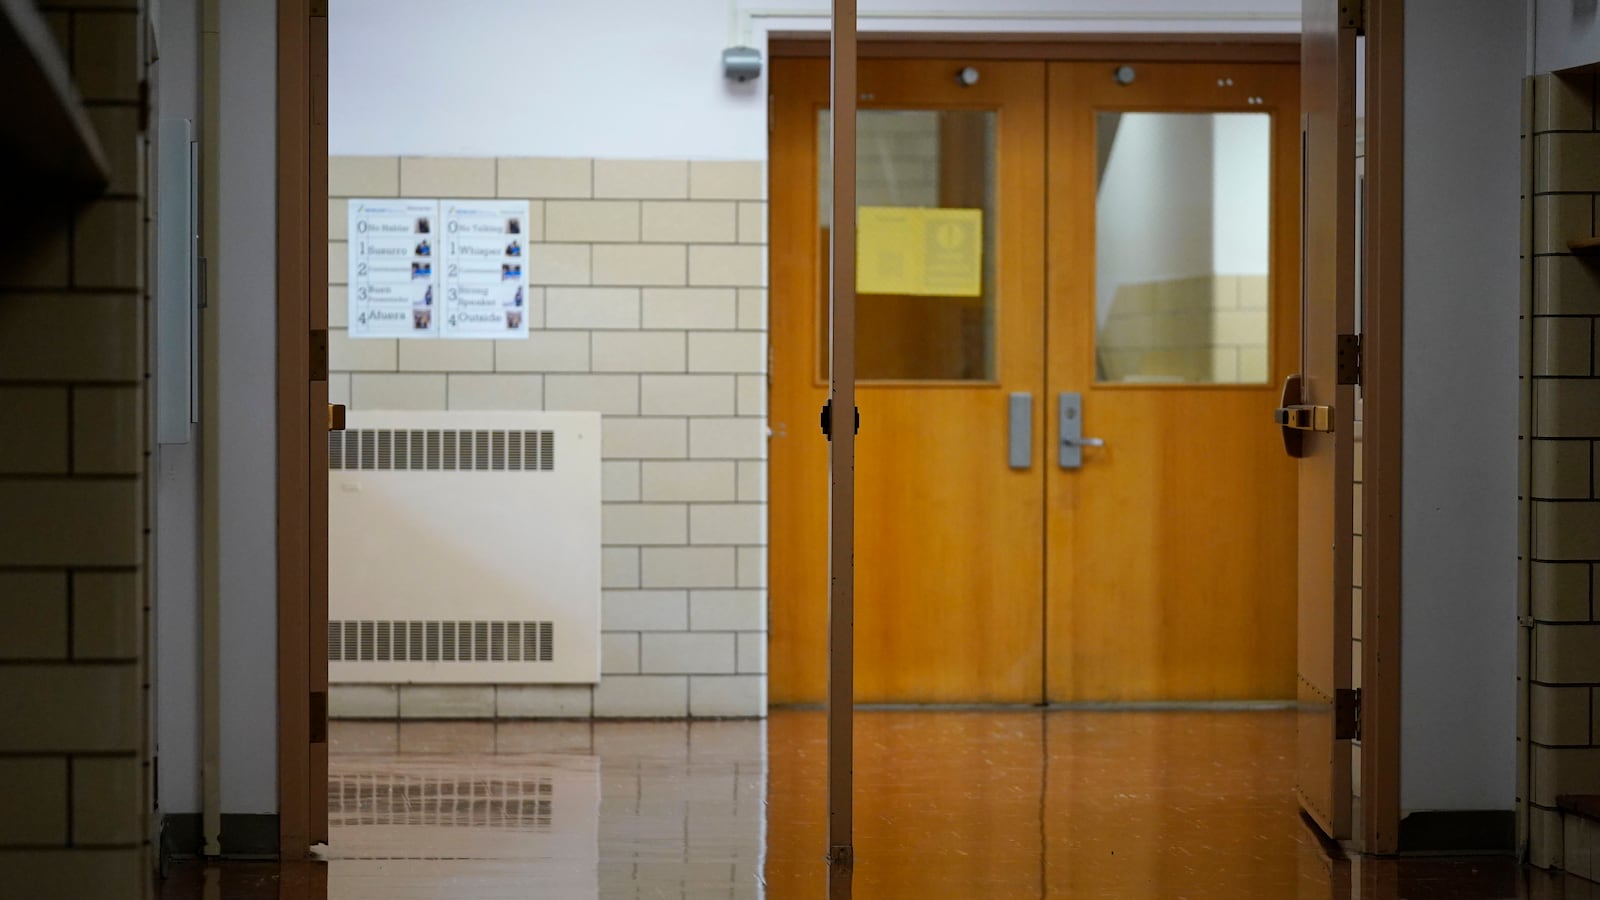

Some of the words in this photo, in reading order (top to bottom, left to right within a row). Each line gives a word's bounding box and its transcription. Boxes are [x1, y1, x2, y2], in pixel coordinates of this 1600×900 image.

[358, 262, 367, 276] 2
[448, 264, 458, 278] 2
[358, 287, 368, 301] 3
[448, 288, 458, 301] 3
[358, 312, 366, 324] 4
[448, 314, 457, 326] 4
